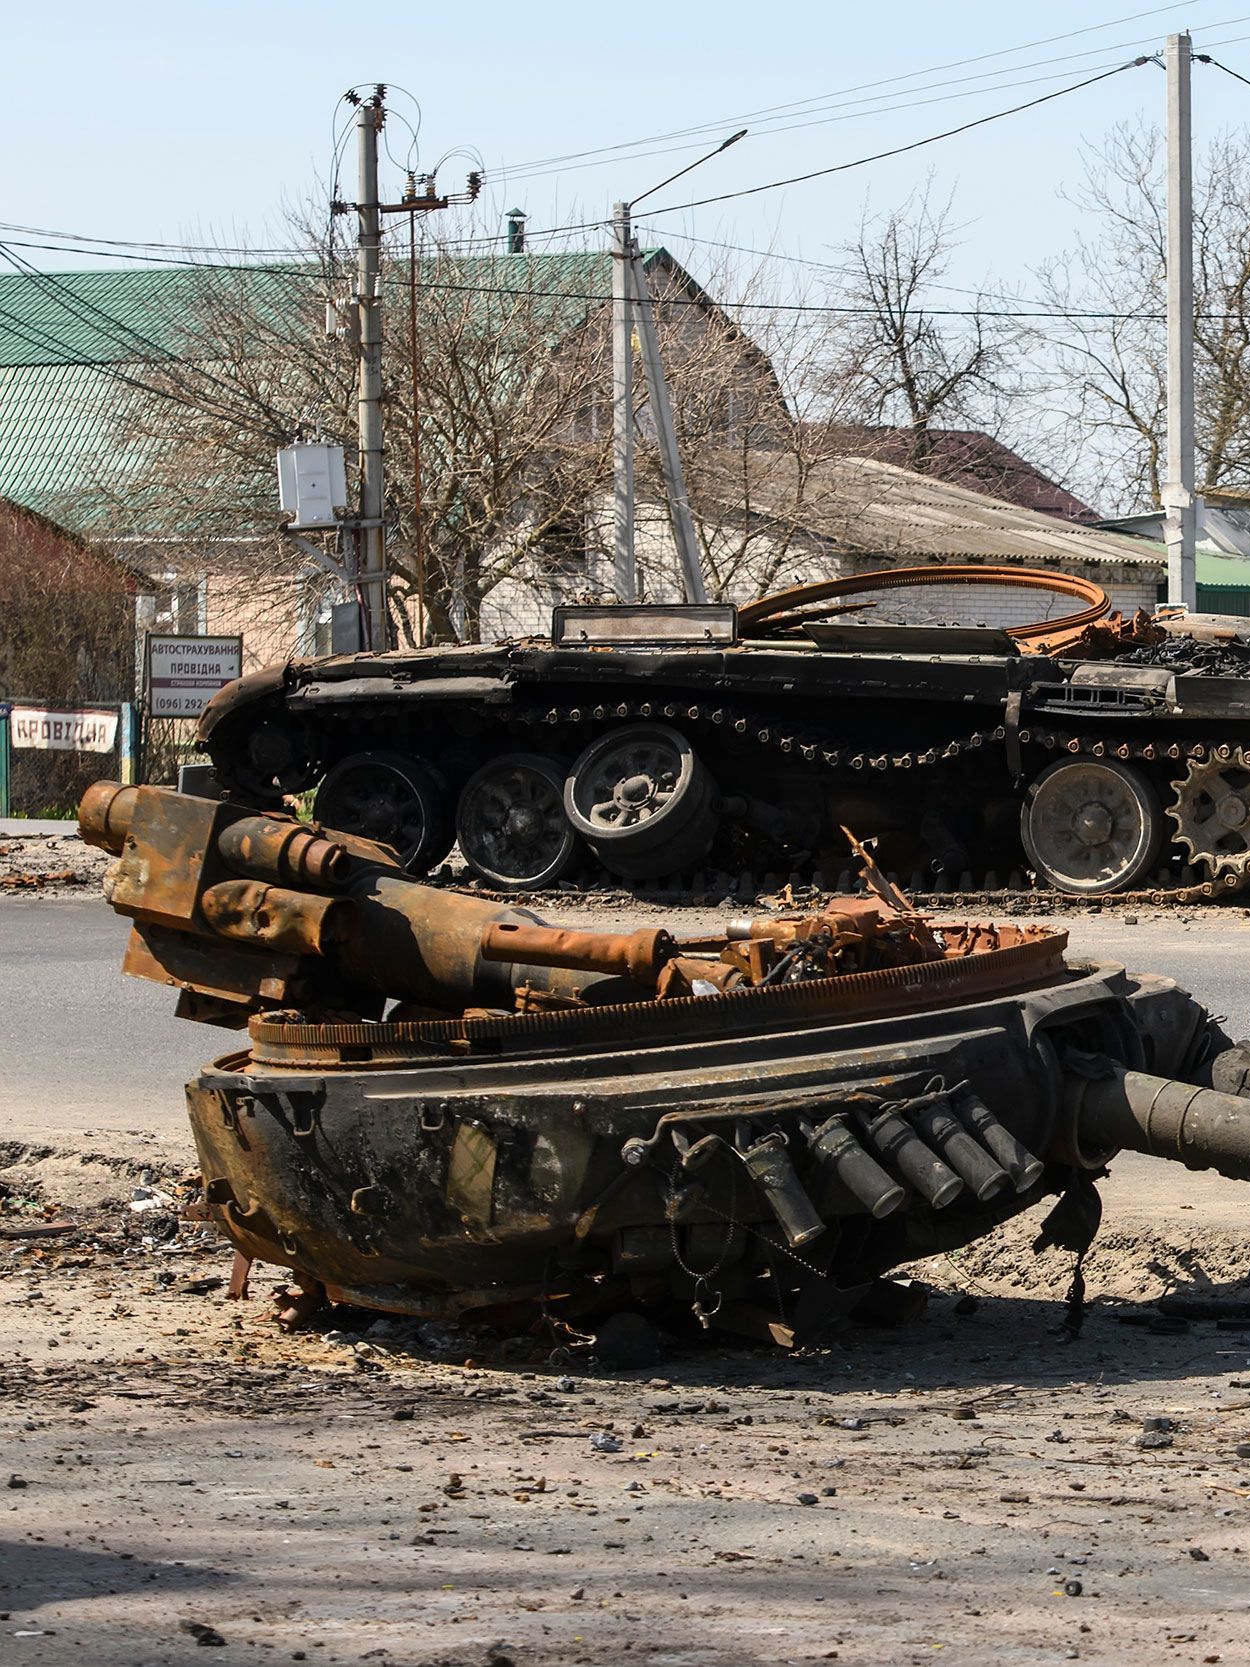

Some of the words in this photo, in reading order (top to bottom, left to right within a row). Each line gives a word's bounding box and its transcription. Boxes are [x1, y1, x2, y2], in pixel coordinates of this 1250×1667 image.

[151, 643, 240, 655] АВТОСТРАХУВАННЯ
[170, 662, 221, 675] ПРОВІДНА
[156, 697, 182, 710] (096)
[185, 698, 211, 709] 292-
